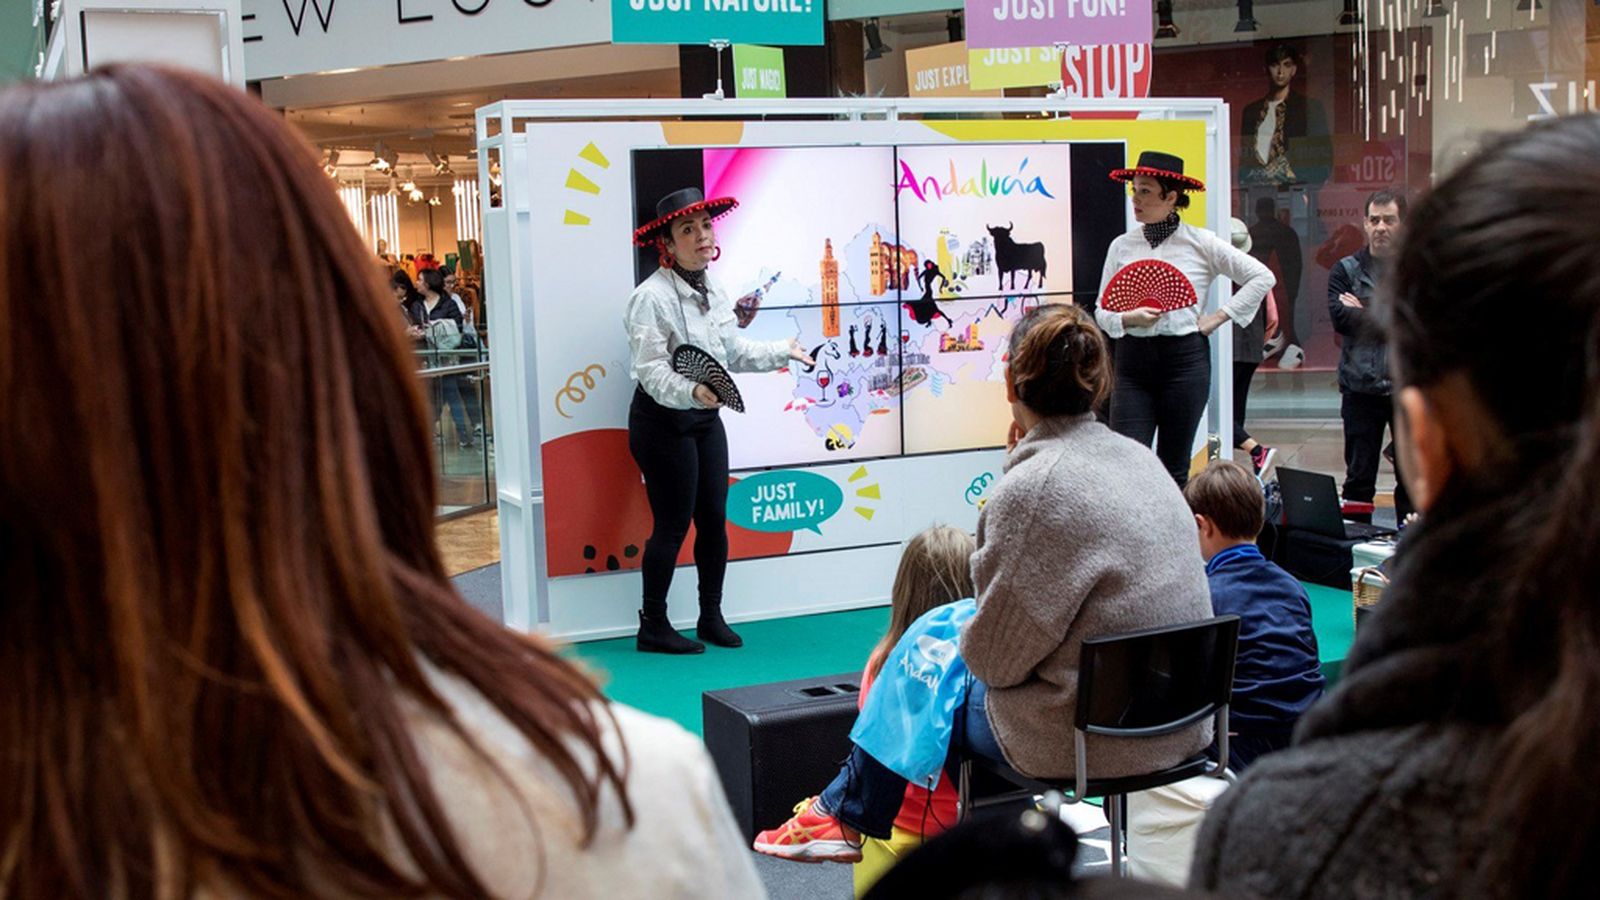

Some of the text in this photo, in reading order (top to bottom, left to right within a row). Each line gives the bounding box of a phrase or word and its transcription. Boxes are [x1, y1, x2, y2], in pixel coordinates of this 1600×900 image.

[915, 68, 940, 92] JUST
[1063, 44, 1145, 98] STOP
[890, 157, 1055, 203] Andalucía
[751, 482, 796, 503] JUST
[752, 498, 824, 524] FAMILY!
